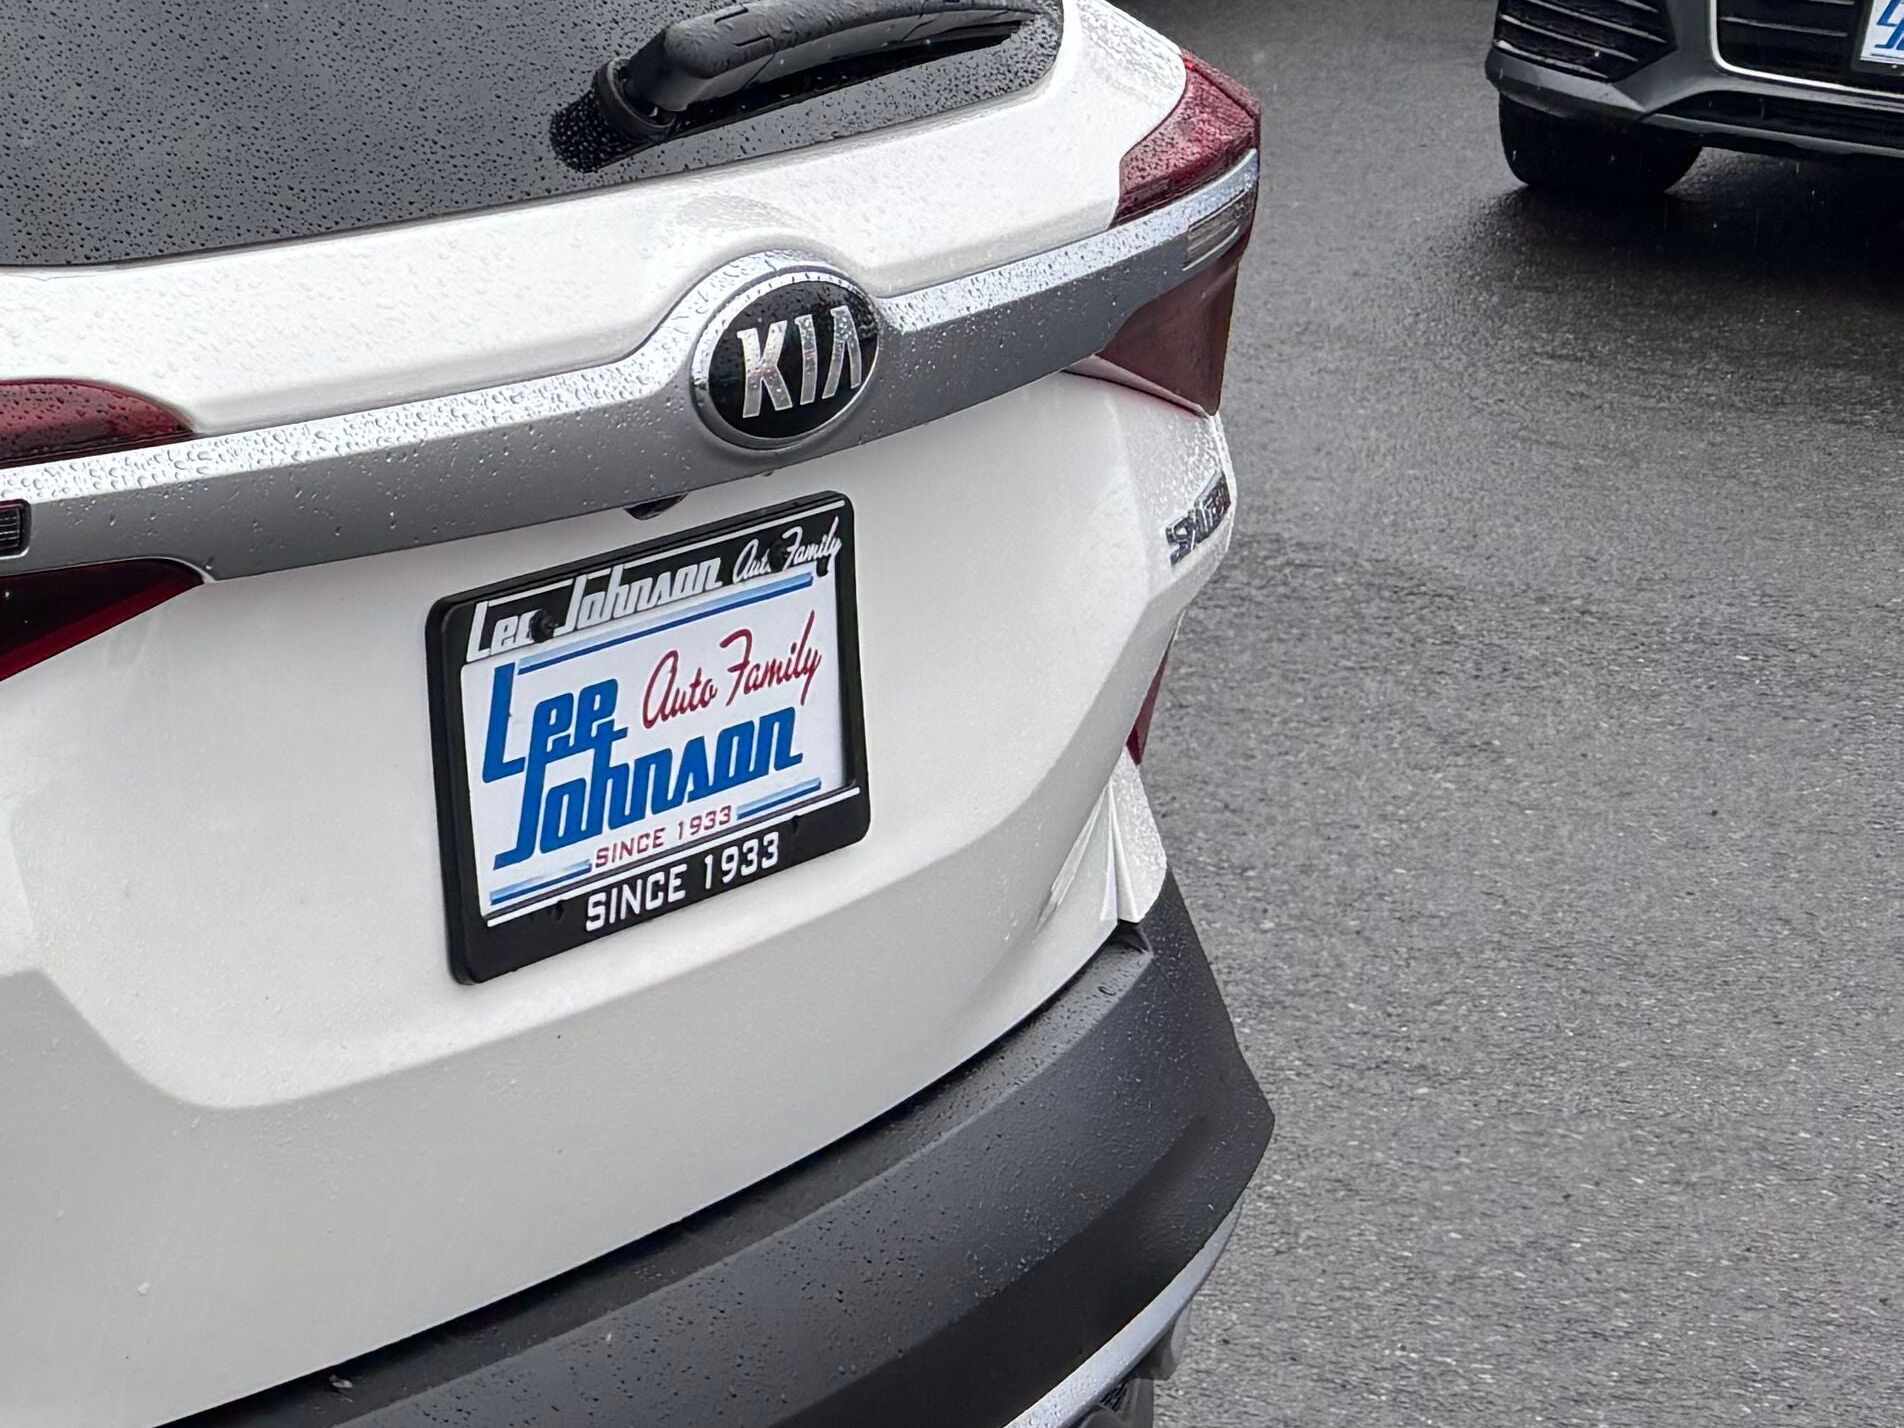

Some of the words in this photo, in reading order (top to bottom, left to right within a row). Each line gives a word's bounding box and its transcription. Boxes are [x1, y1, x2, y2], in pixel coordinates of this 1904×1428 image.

[736, 306, 864, 419] KIA
[553, 557, 723, 638] Johnson
[781, 515, 843, 572] Family
[482, 662, 620, 784] Lee
[642, 649, 718, 730] Auto
[719, 610, 823, 707] Family
[493, 706, 804, 871] Johnson
[594, 831, 666, 868] SINCE
[676, 805, 733, 841] 1933
[585, 869, 687, 932] SINCE
[703, 831, 781, 890] 1933
